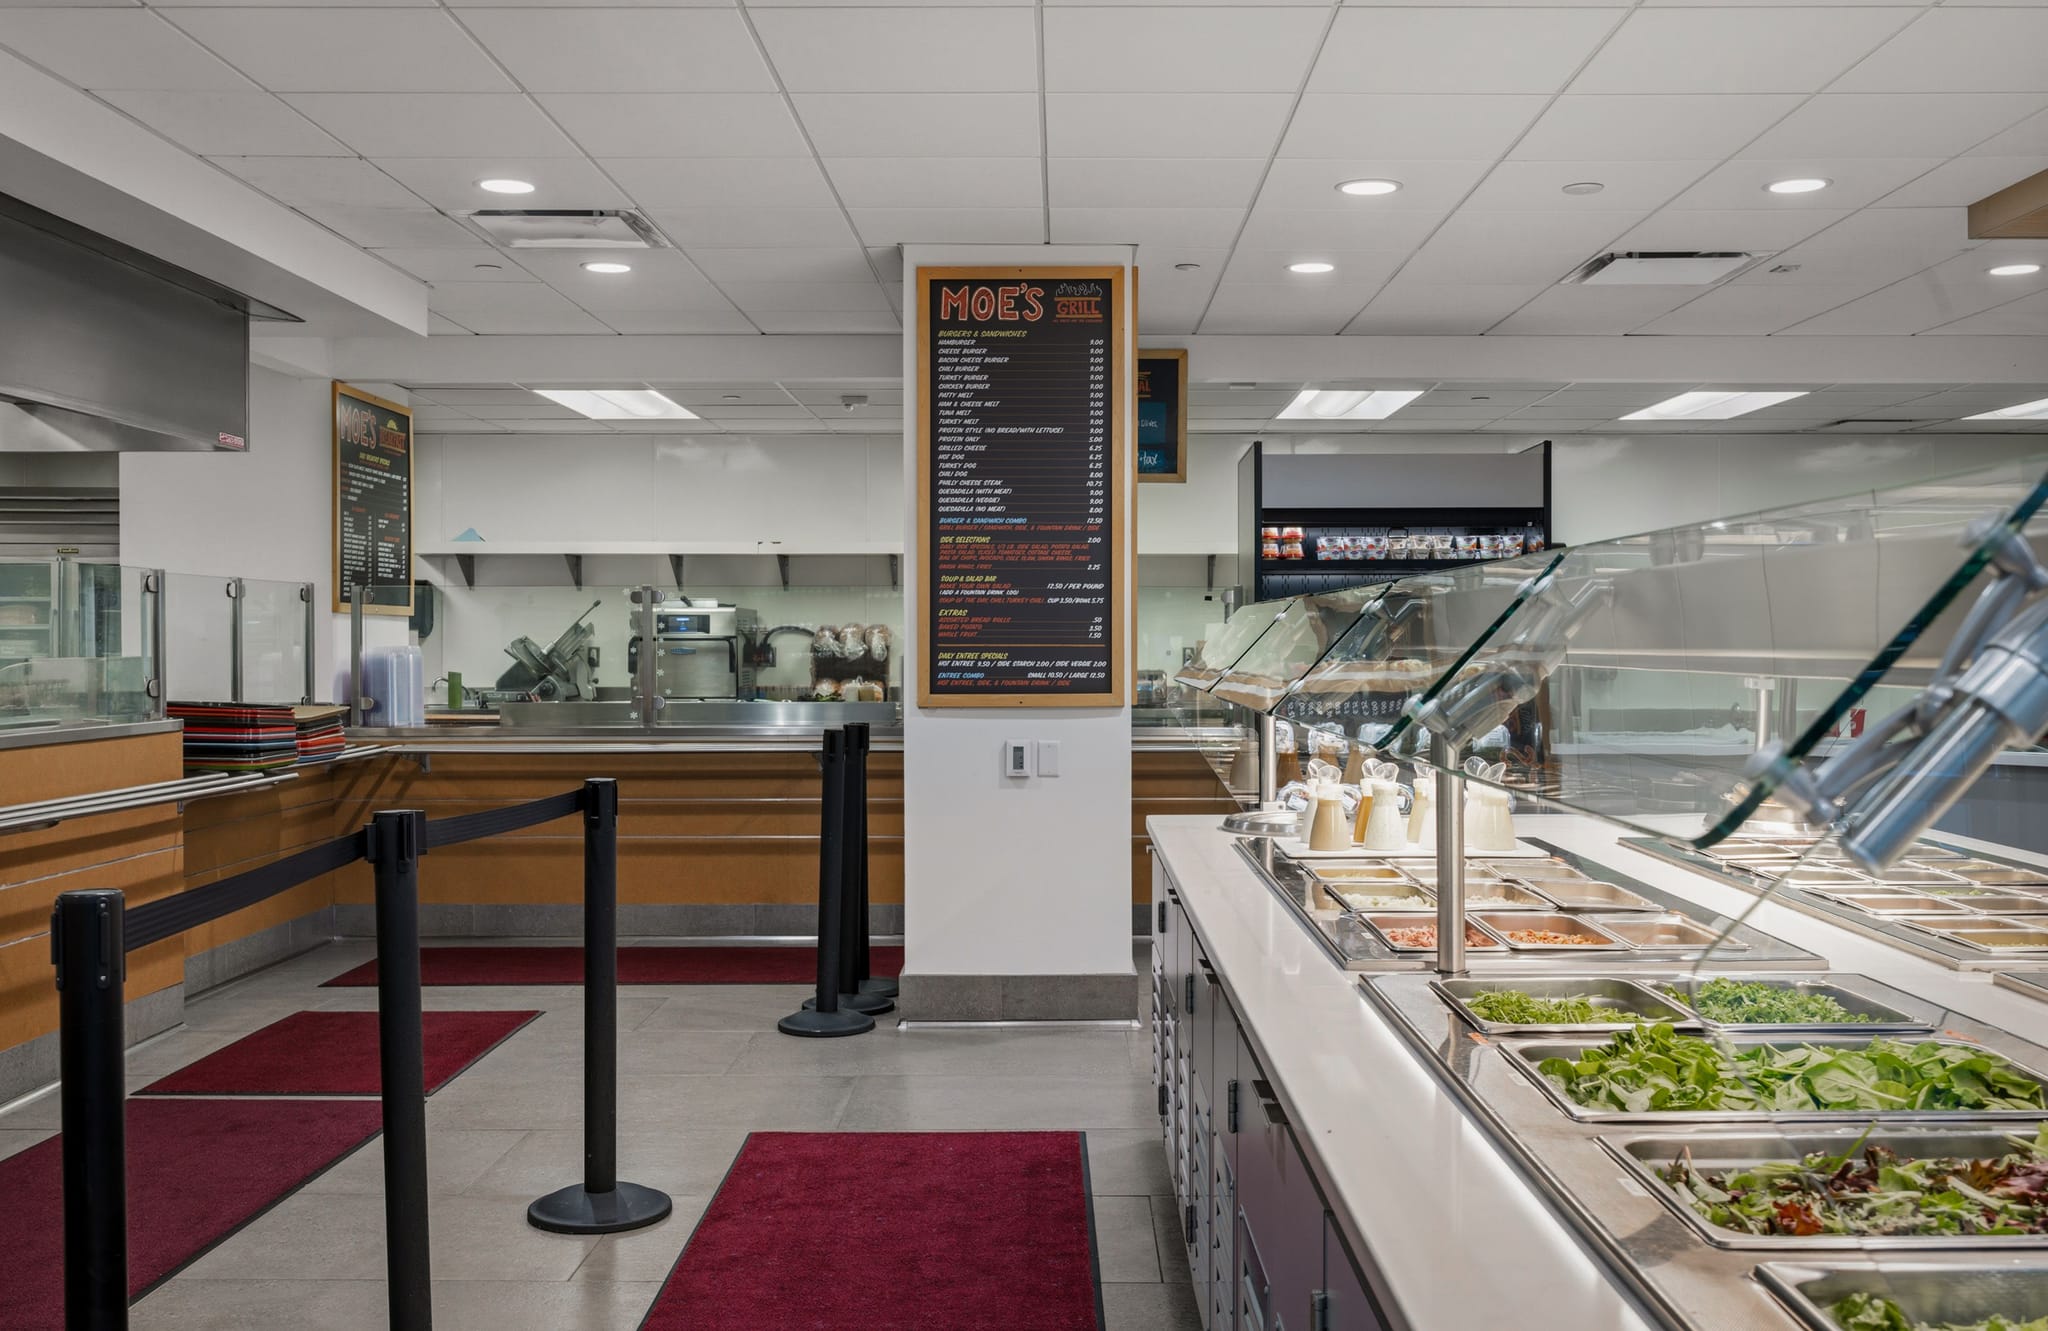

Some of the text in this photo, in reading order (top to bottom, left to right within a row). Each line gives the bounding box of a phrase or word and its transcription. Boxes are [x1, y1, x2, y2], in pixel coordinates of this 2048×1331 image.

[940, 282, 1100, 321] MOE'S GRILL
[341, 405, 377, 449] MOE'S
